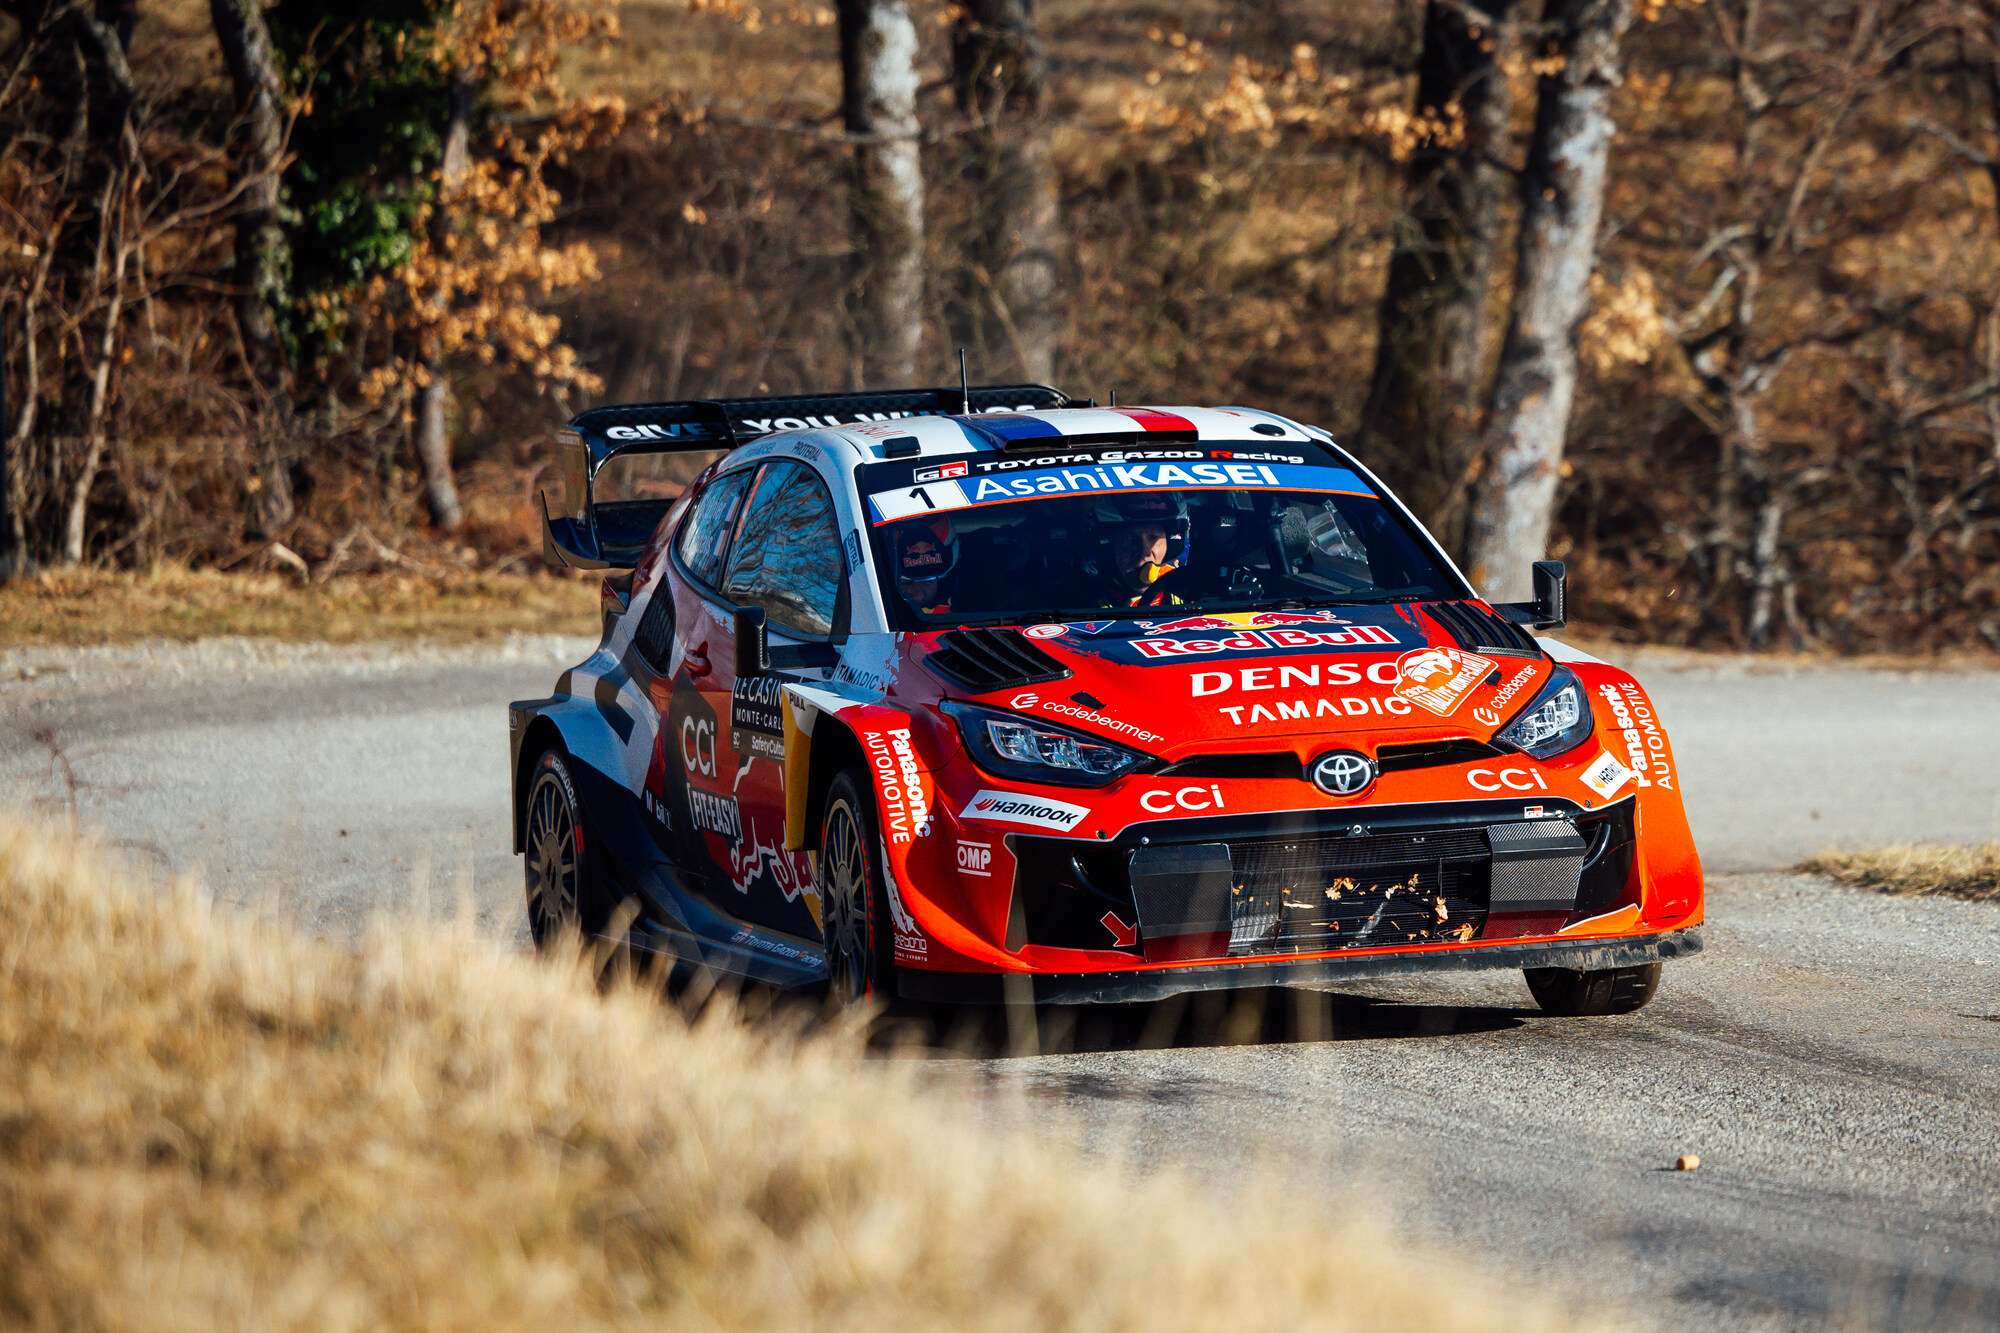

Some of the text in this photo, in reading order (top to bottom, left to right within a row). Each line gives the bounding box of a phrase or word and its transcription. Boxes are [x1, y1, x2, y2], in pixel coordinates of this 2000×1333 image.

[606, 423, 713, 440] GIVE
[916, 466, 967, 482] GR
[976, 450, 1304, 472] TOYOTA GAZOO Racing
[908, 487, 936, 509] 1
[903, 553, 943, 567] Red Bull
[1128, 625, 1400, 658] Red Bull
[838, 664, 879, 690] TAMADIC
[1190, 662, 1400, 697] DENSO
[1490, 664, 1538, 709] codebeamer
[735, 677, 782, 708] LE CASIN
[1042, 700, 1162, 744] codebeamer
[1219, 696, 1412, 725] TAMADIC
[1598, 684, 1652, 787] Panasonic
[1618, 682, 1673, 790] AUTOMOTIVE
[864, 731, 910, 844] AUTOMOTIVE
[887, 728, 934, 837] Panasonic
[957, 846, 992, 870] OMP
[745, 935, 774, 951] TOYOTA
